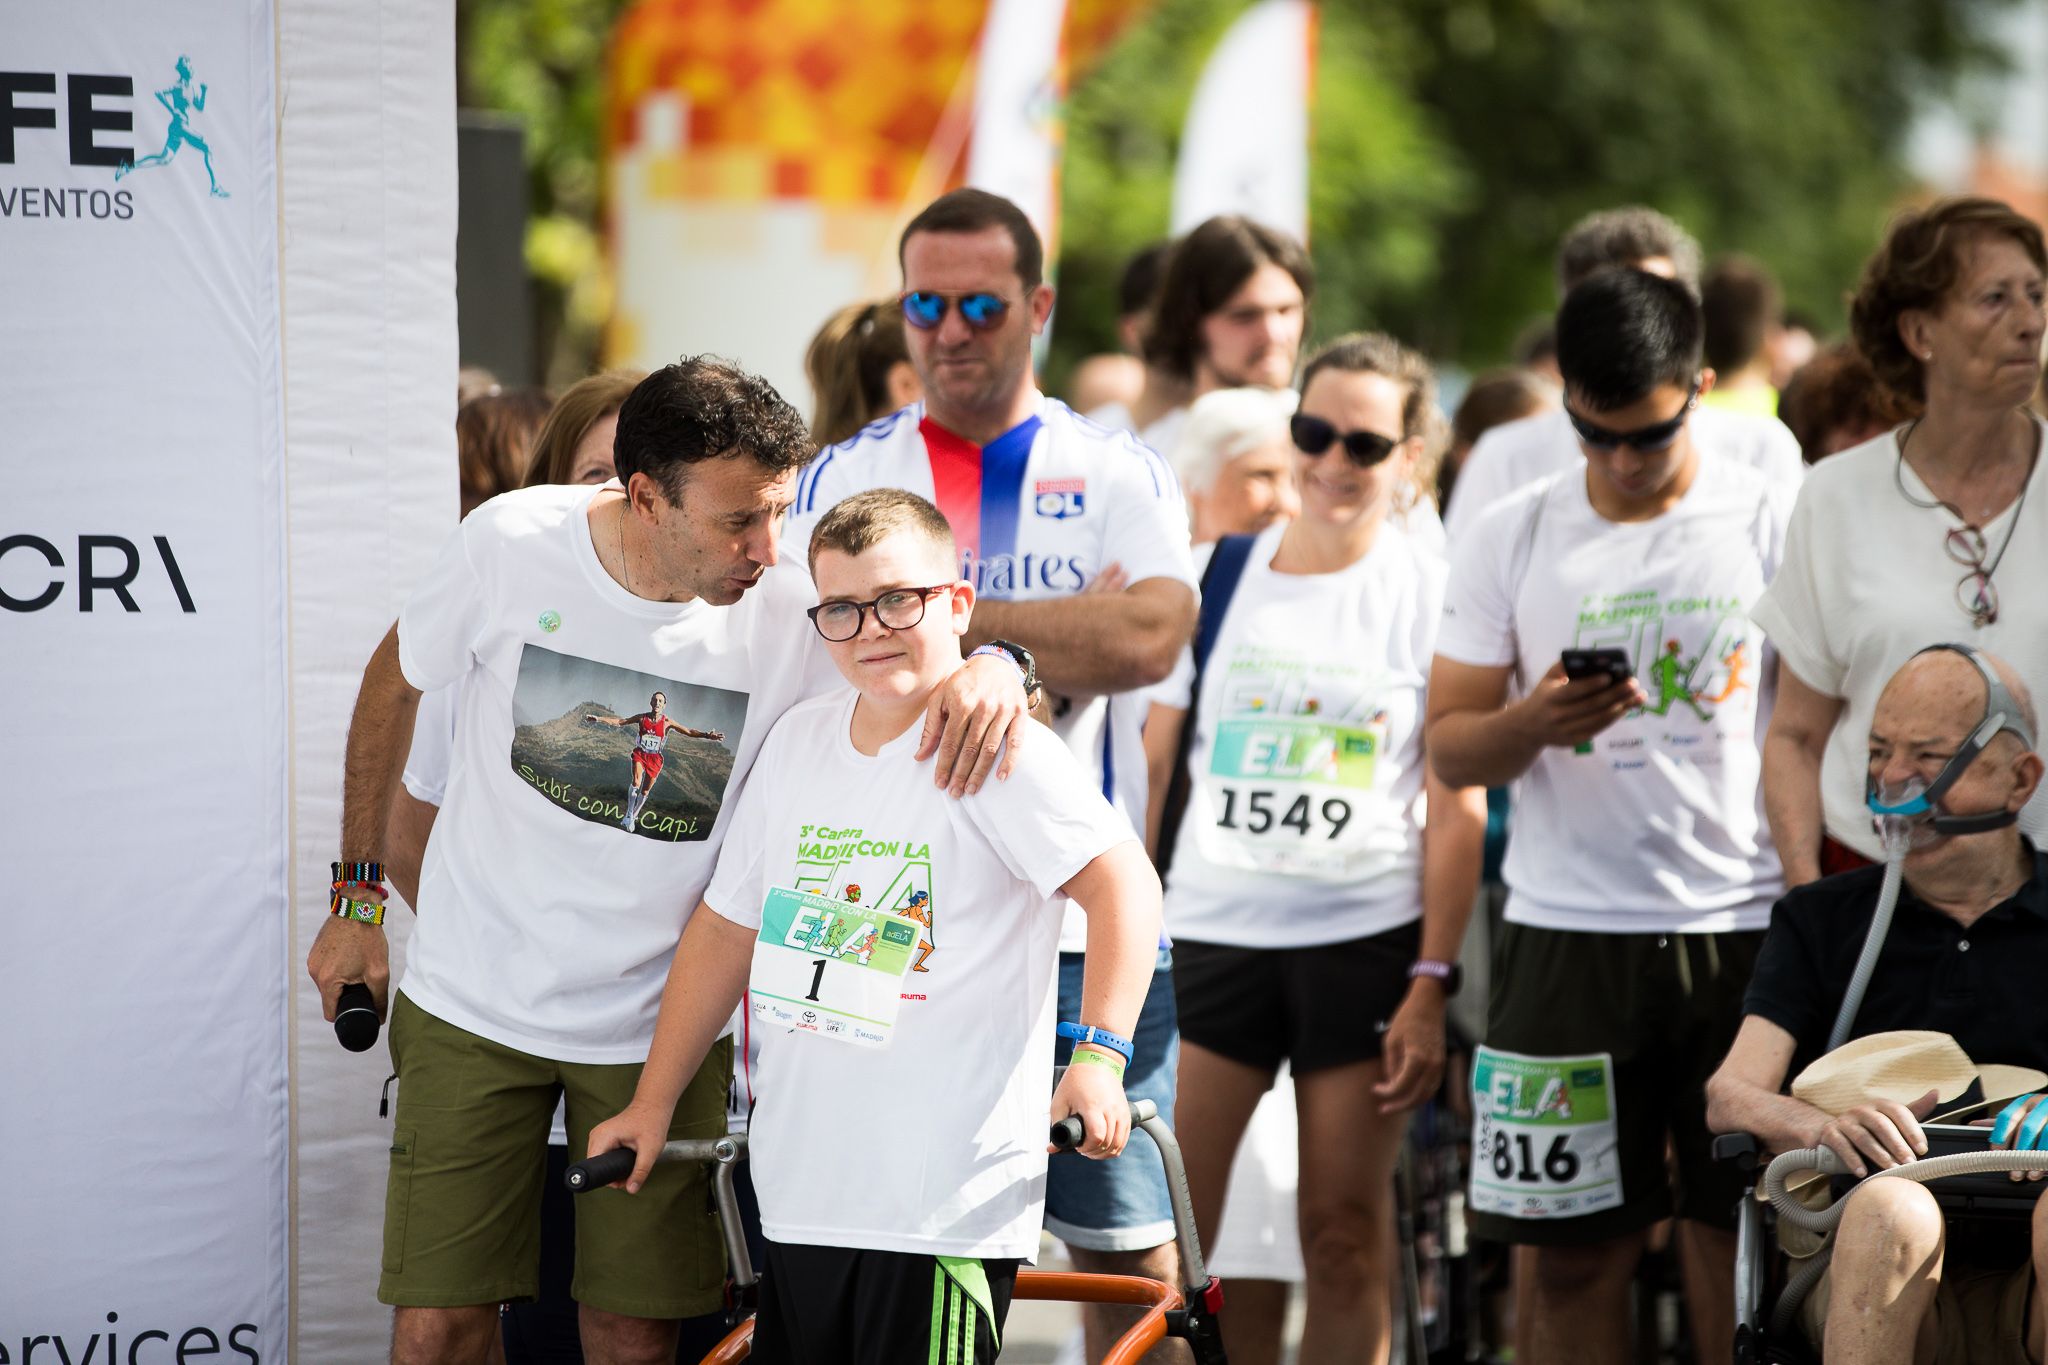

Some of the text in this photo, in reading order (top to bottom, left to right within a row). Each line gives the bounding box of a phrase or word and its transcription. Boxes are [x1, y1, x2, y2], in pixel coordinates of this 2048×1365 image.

[0, 188, 134, 220] VENTOS
[578, 796, 625, 819] con
[640, 811, 698, 842] Capi
[1217, 787, 1352, 840] 1549
[857, 840, 900, 857] CON
[904, 842, 930, 860] LA
[802, 895, 840, 911] MADRID
[841, 905, 864, 917] CON
[864, 911, 877, 921] LA
[784, 906, 875, 965] ELA
[805, 960, 827, 1001] 1
[827, 1025, 840, 1033] LIFE
[1490, 1071, 1572, 1120] ELA
[1494, 1129, 1581, 1184] 816
[0, 1311, 259, 1365] rvices
